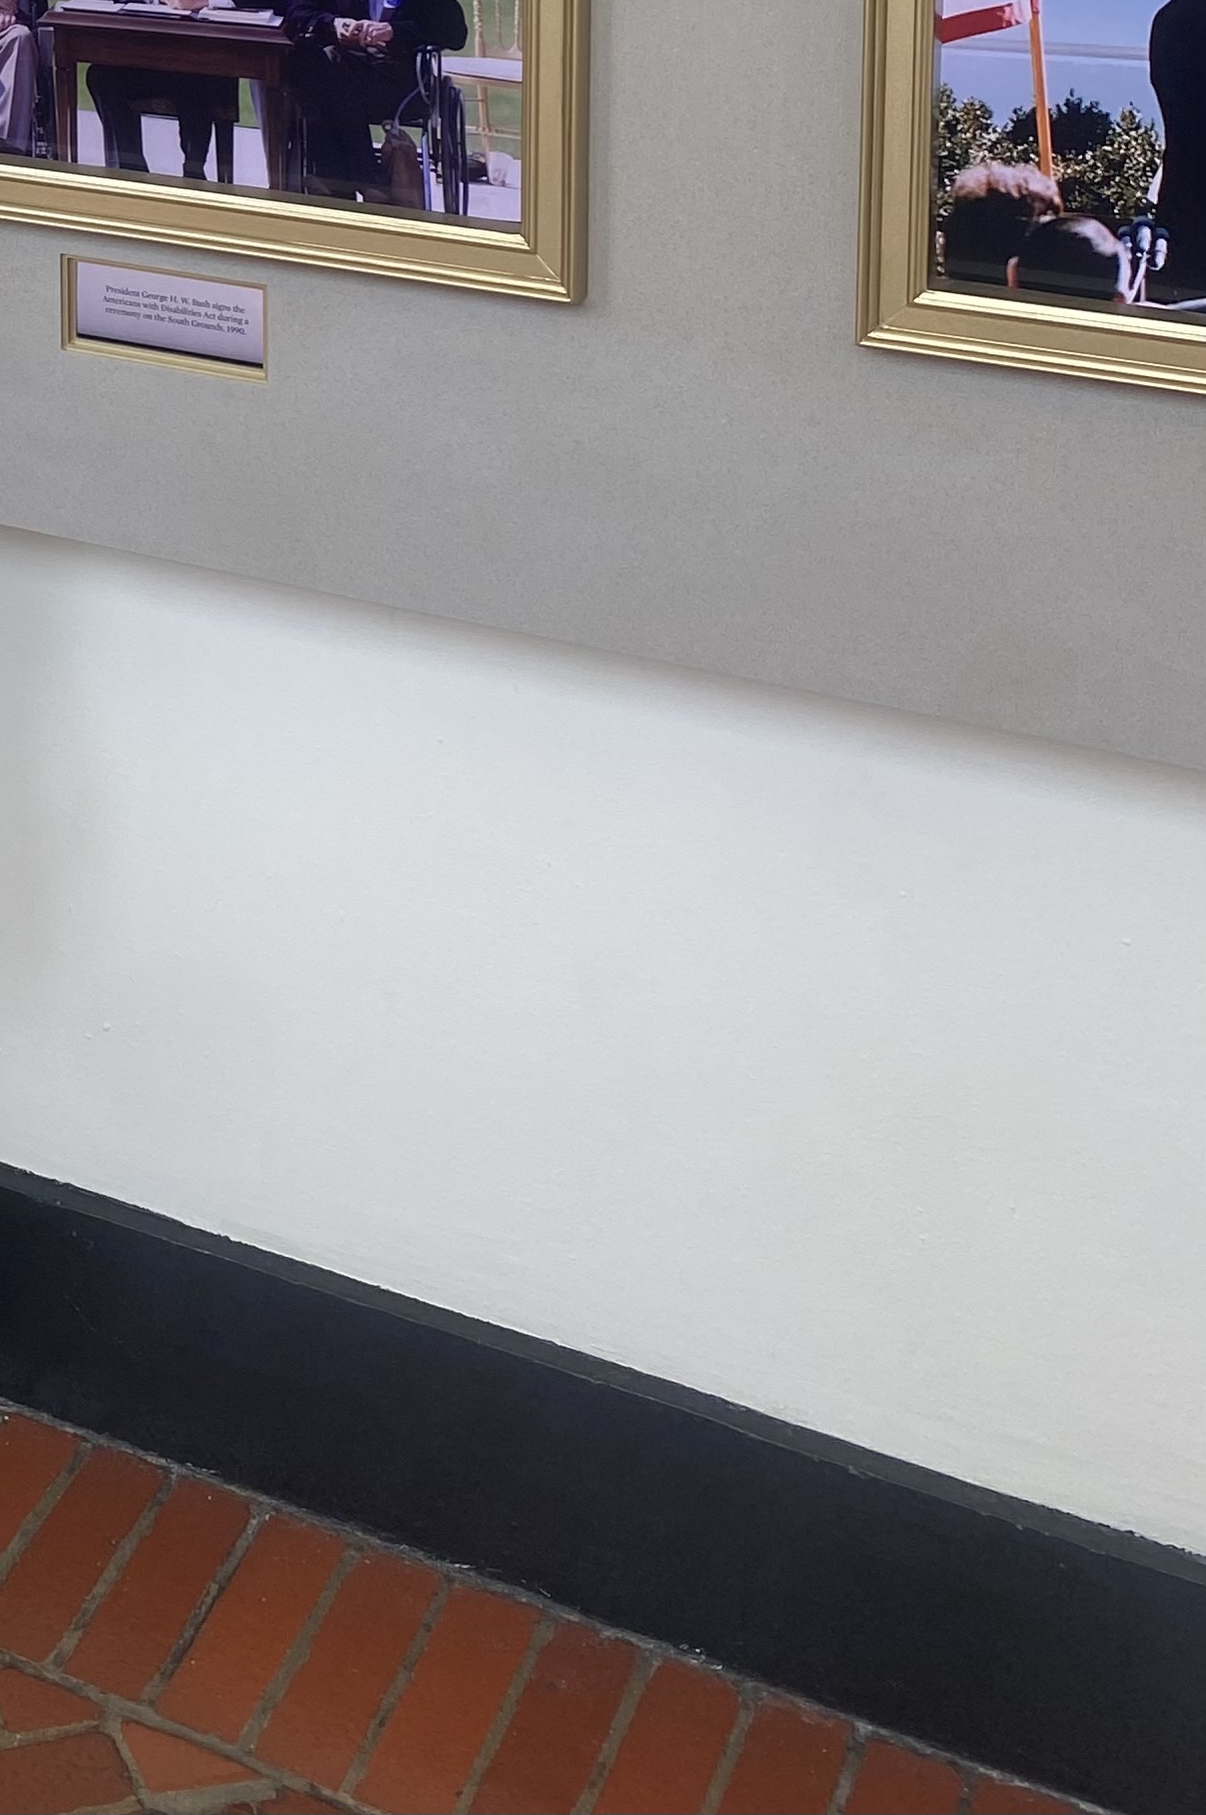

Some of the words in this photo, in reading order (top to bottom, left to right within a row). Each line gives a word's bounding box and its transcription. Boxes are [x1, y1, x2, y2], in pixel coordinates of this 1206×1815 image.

[103, 296, 141, 308] Americans
[142, 301, 159, 311] with
[161, 304, 202, 318] Disabilities
[203, 311, 216, 319] Act
[217, 312, 243, 325] during
[106, 285, 140, 297] President
[141, 291, 169, 303] George
[170, 295, 179, 303] H.
[181, 297, 190, 306] W.
[192, 298, 211, 308] Bush
[212, 303, 231, 314] signs
[232, 304, 246, 314] the
[106, 307, 141, 320] ceremony
[154, 314, 166, 323] the
[168, 317, 189, 326] South
[227, 325, 246, 335] 1990.
